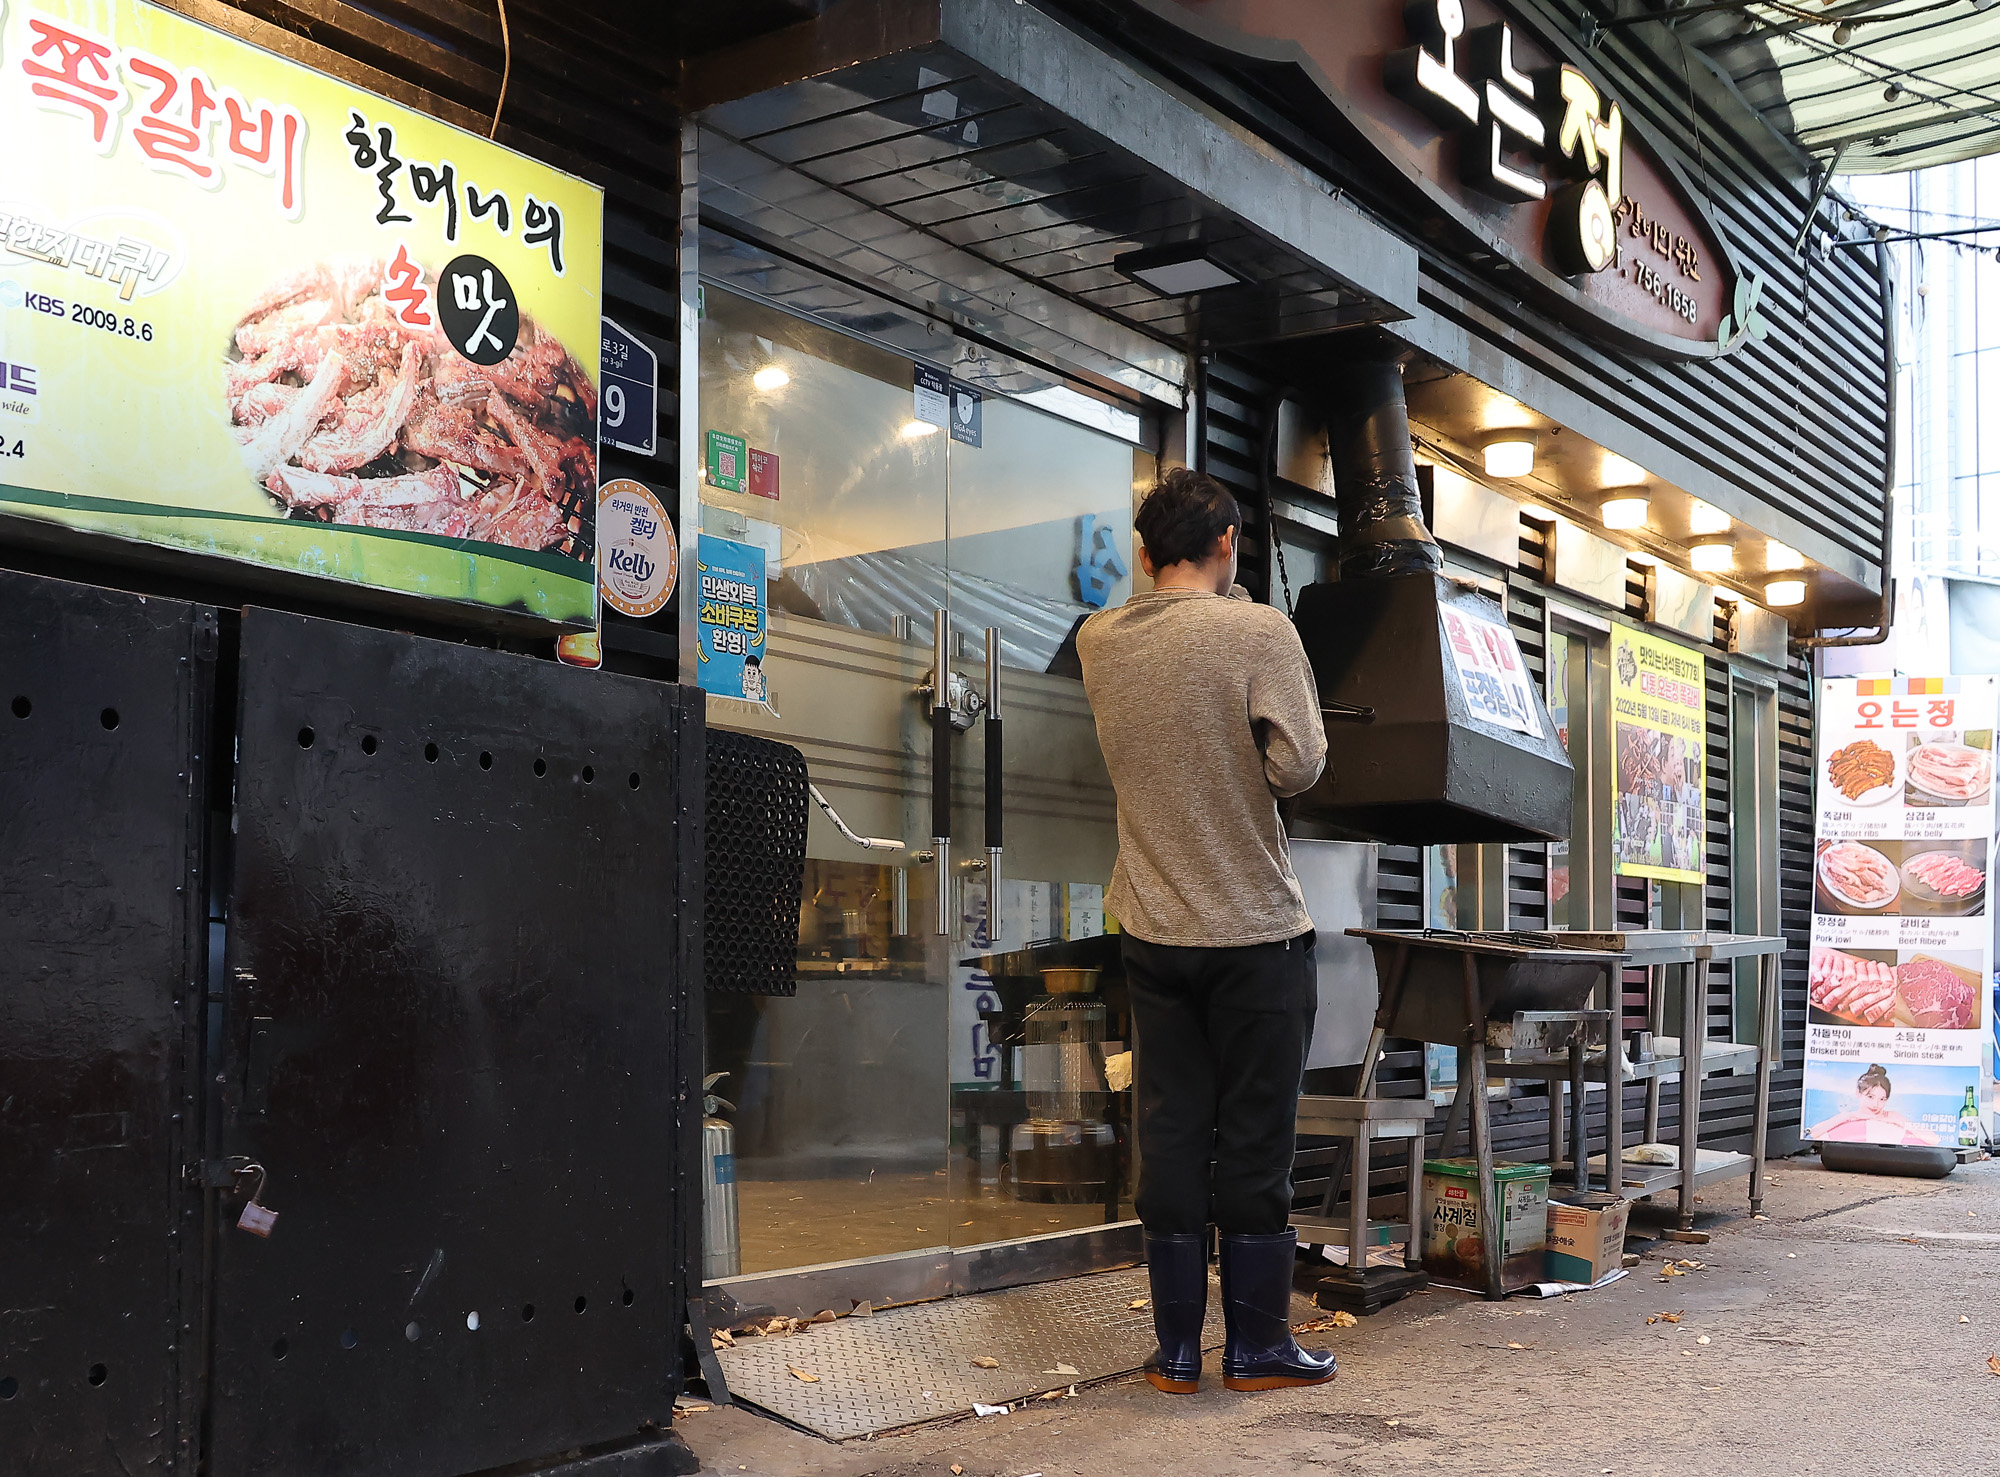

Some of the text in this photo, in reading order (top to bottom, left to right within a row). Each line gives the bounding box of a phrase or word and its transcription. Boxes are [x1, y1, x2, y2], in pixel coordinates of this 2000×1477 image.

[22, 19, 298, 209] 쪽갈비
[346, 112, 563, 273] 할머니의
[1636, 259, 1697, 324] 756.1658
[25, 291, 153, 342] KBS 2009.8.6
[612, 499, 649, 518] 라거의 반전
[630, 517, 657, 540] 켈리
[609, 548, 655, 581] Kelly
[701, 574, 758, 608] 민생회복
[700, 601, 758, 633] 소비쿠폰
[712, 628, 747, 656] 환영!
[1854, 699, 1955, 729] 오는정
[1823, 811, 1852, 821] 쪽갈비
[1906, 811, 1935, 821] 삼겹살
[1821, 828, 1838, 837] Pork
[1903, 829, 1943, 838] Pork belly
[1900, 918, 1930, 929] 갈비살
[1815, 934, 1852, 944] Pork jowl
[1898, 937, 1947, 946] Beef Ribeye
[1811, 1028, 1852, 1039] 차돌박이
[1895, 1031, 1926, 1042] 소등심
[1810, 1046, 1860, 1057] Brisket point
[1893, 1050, 1944, 1060] Sirloin steak
[1433, 1205, 1477, 1228] 사계절
